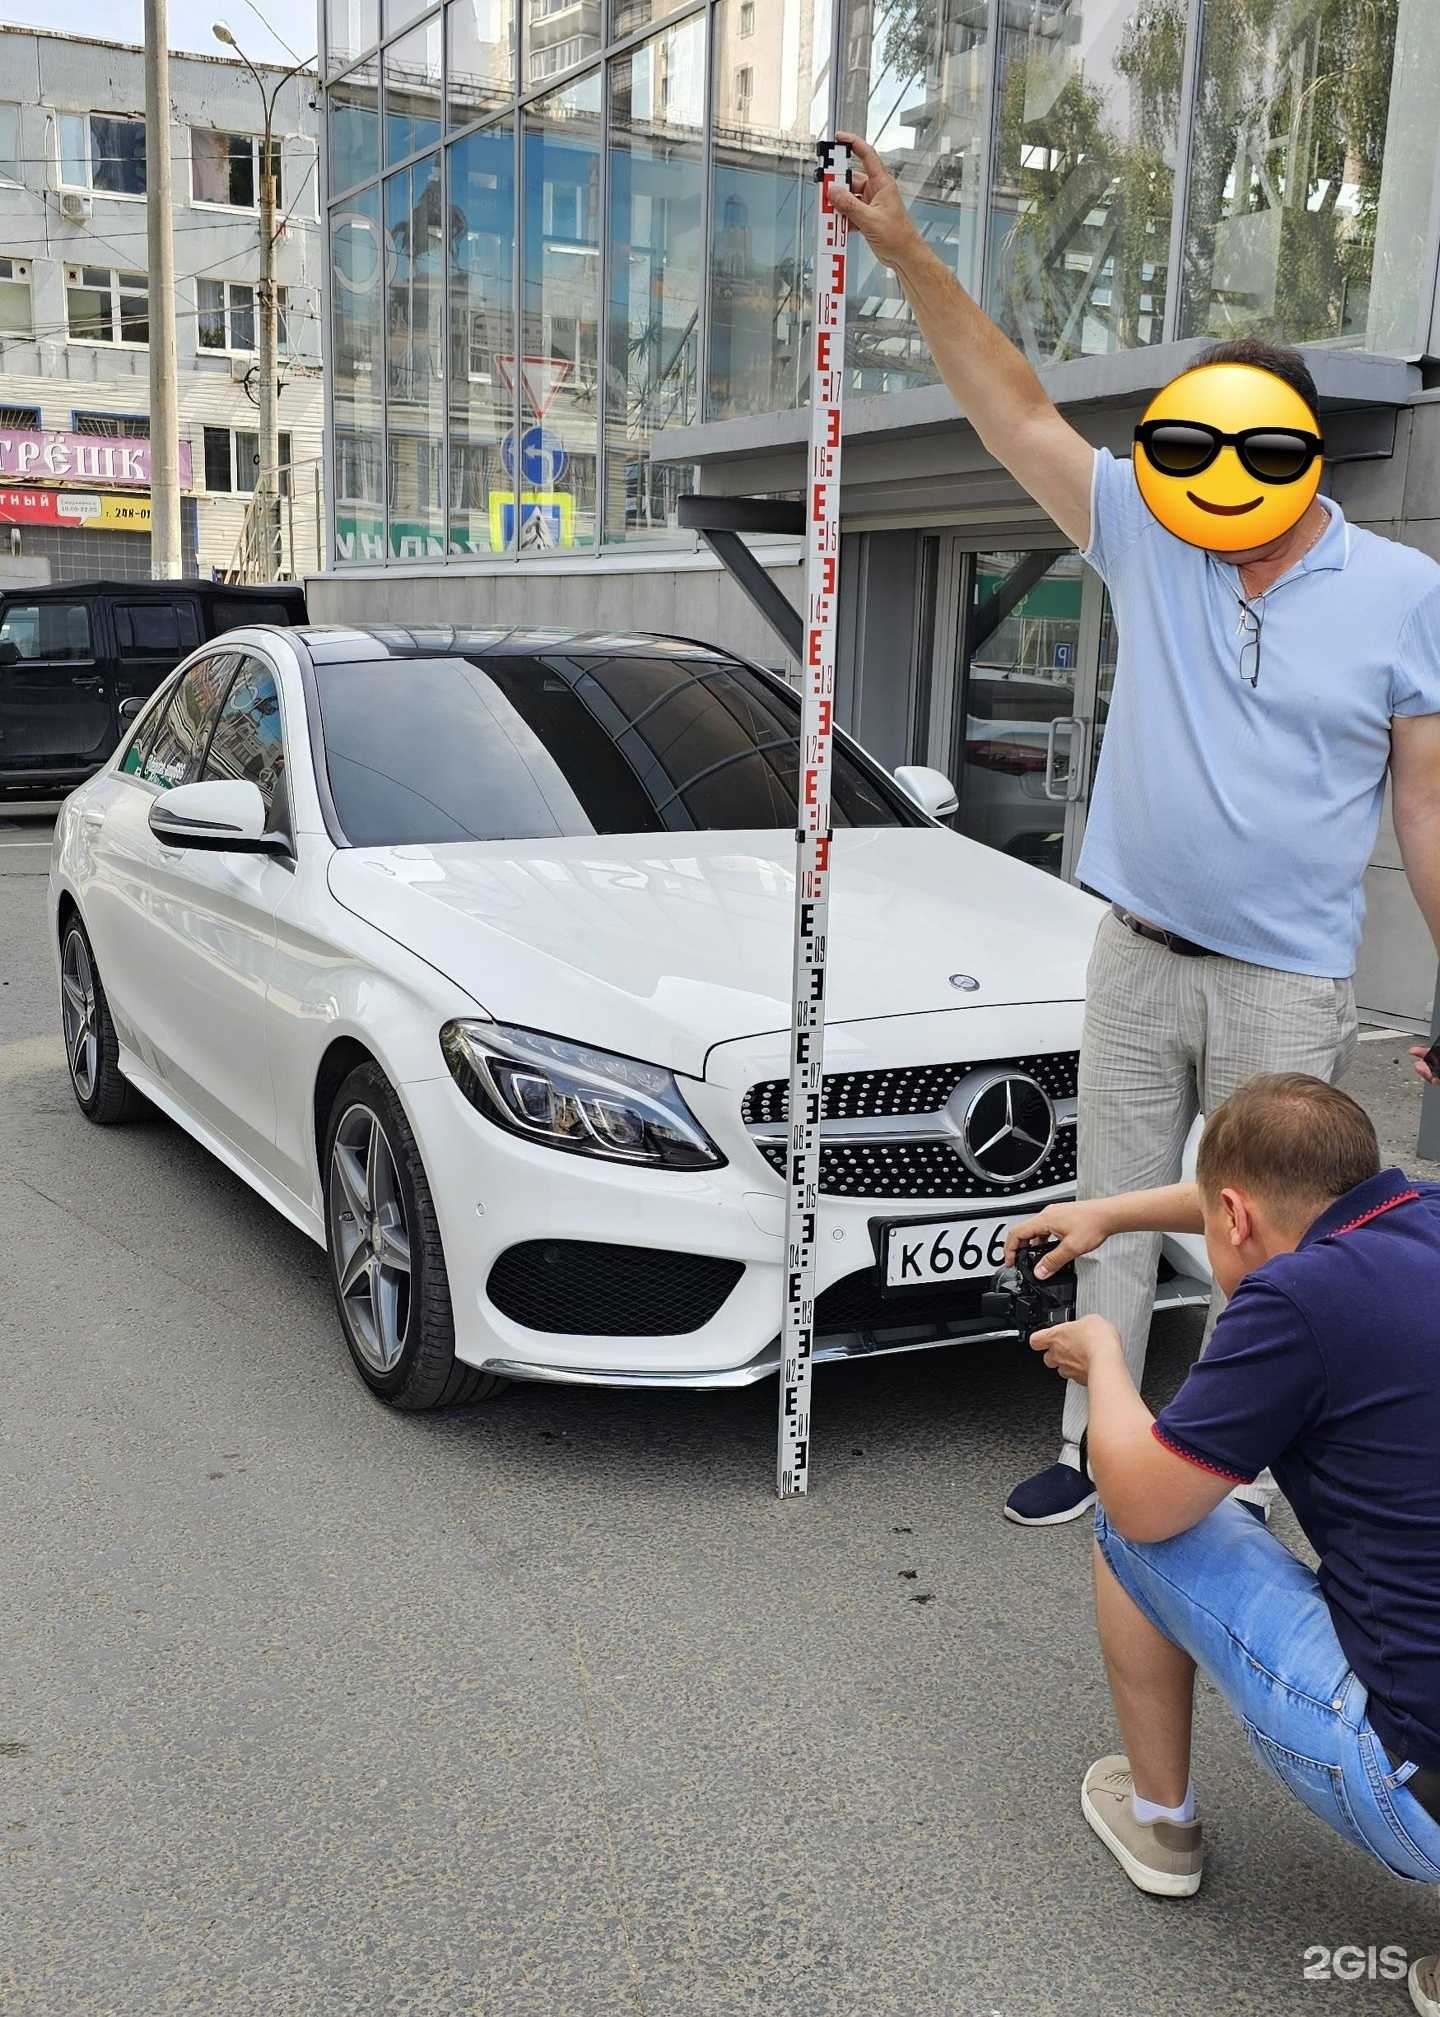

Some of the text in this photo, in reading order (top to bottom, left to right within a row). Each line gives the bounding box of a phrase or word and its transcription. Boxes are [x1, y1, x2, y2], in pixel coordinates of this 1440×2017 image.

[834, 214, 847, 247] 19
[818, 292, 830, 325] 18
[830, 371, 842, 403] 17
[814, 446, 825, 477] 16
[825, 520, 837, 551] 15
[810, 593, 821, 624] 14
[821, 665, 832, 694] 13
[806, 735, 817, 765] 12
[817, 803, 829, 831] 11
[802, 871, 812, 898] 10
[814, 935, 825, 963] 09
[797, 1000, 808, 1027] 08
[810, 1063, 820, 1089] 07
[793, 1124, 804, 1150] 06
[806, 1183, 816, 1208] 05
[789, 1243, 800, 1268] 04
[901, 1223, 1007, 1279] К666
[802, 1300, 812, 1324] 03
[785, 1358, 796, 1383] 02
[798, 1412, 808, 1437] 01
[782, 1470, 793, 1494] 00
